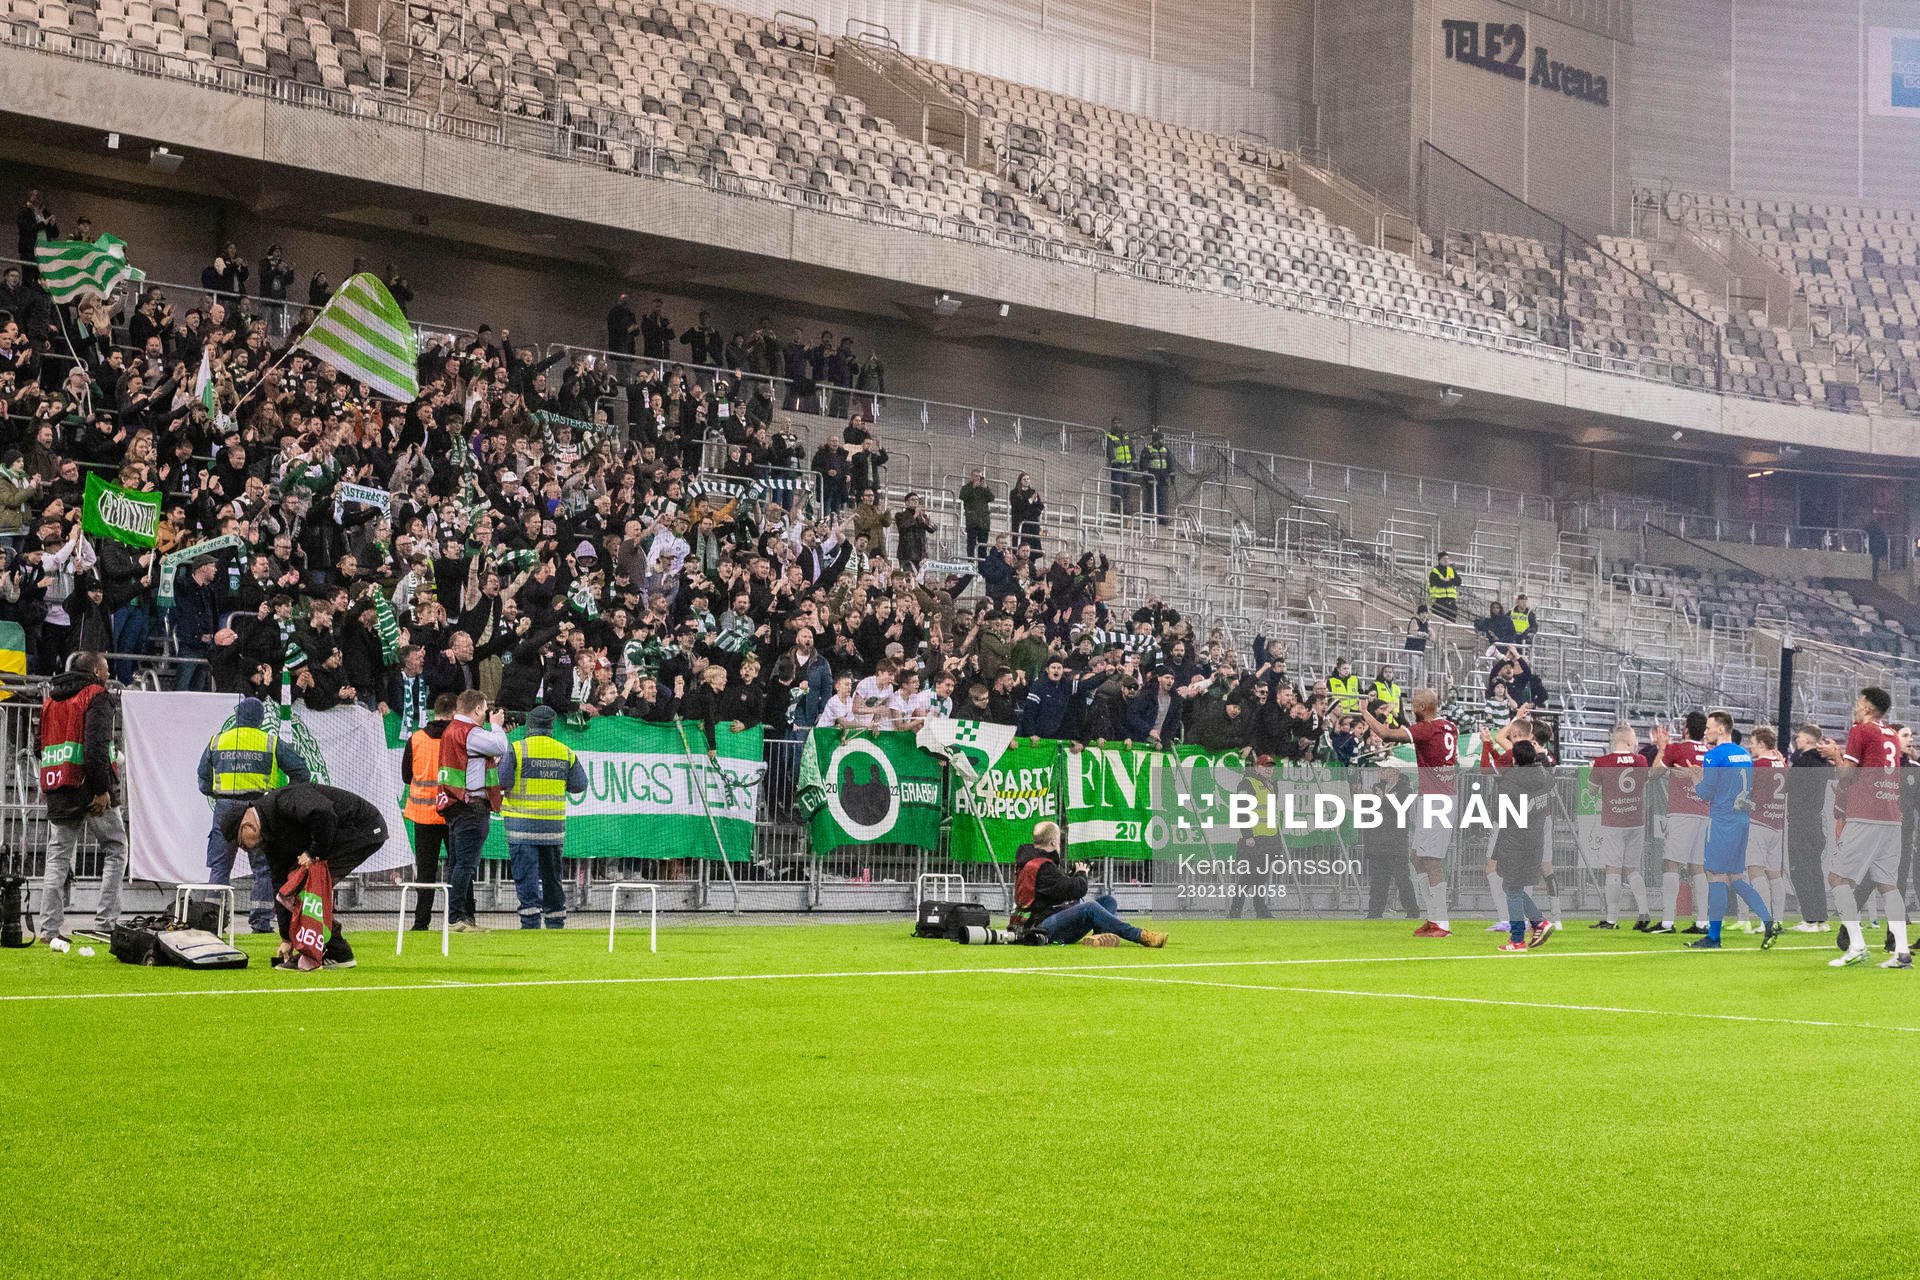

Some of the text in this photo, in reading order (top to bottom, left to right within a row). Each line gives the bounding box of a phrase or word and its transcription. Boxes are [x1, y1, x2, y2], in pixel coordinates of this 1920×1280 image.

[1442, 19, 1610, 107] TELE2 Arena
[220, 751, 263, 761] ORDNINGS
[1443, 732, 1455, 762] 9
[1883, 741, 1897, 776] 3
[231, 762, 252, 771] VAKT
[539, 769, 559, 780] VAKT
[990, 764, 1054, 792] PARTY
[1618, 767, 1636, 794] 6
[1773, 772, 1786, 800] 2
[1115, 822, 1138, 841] 20
